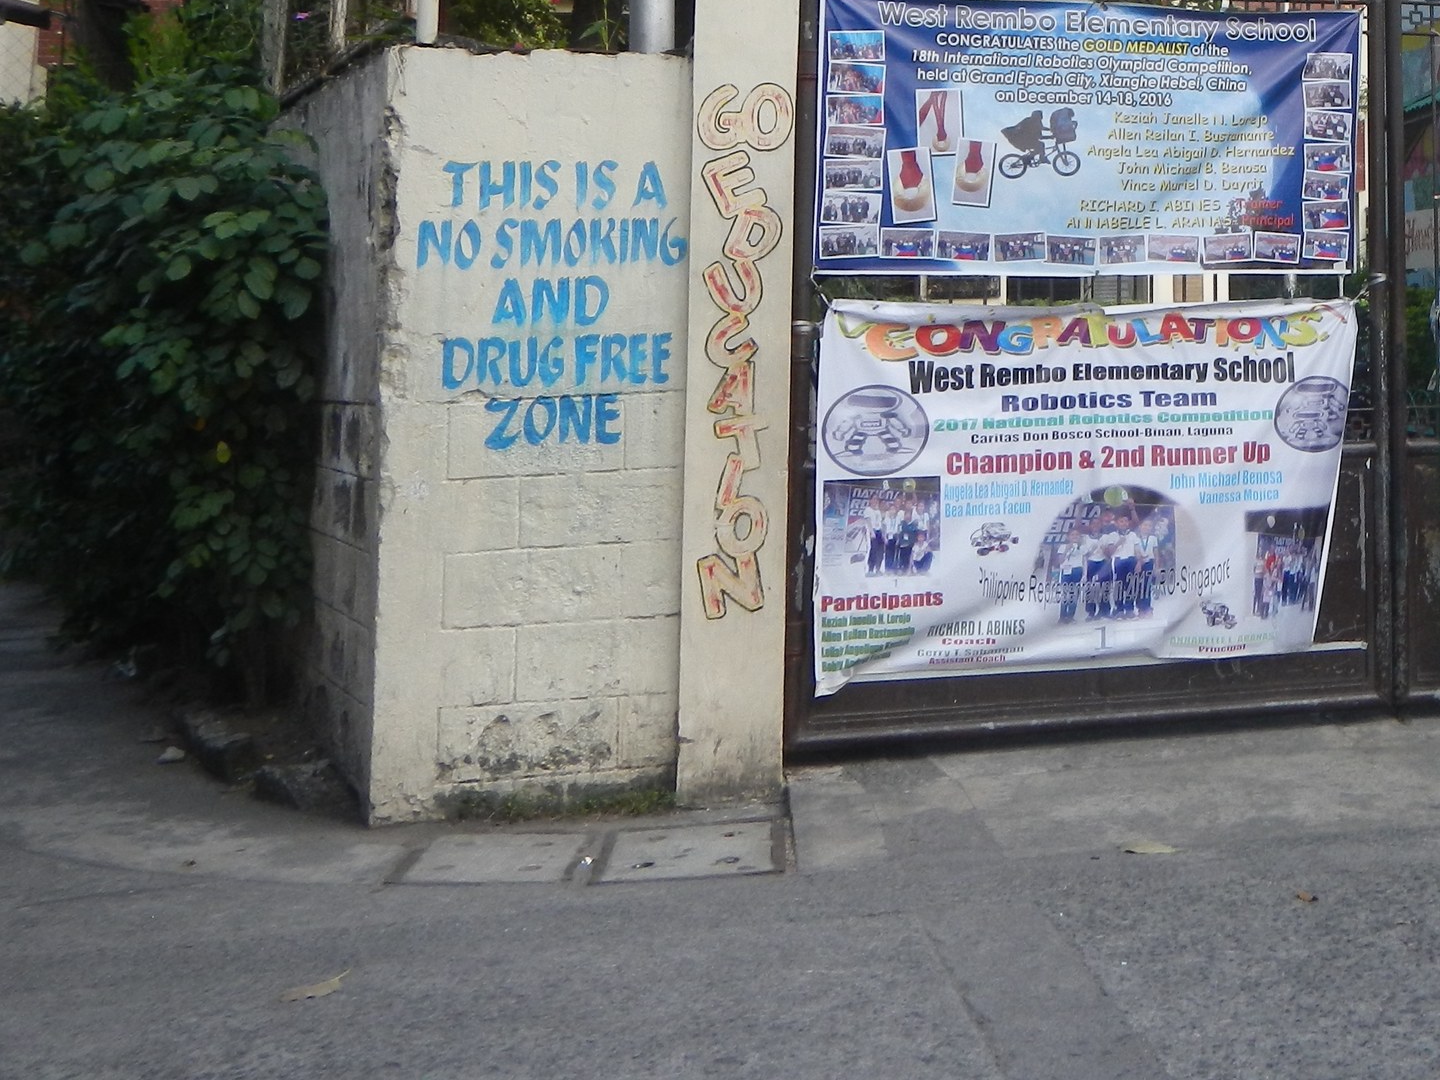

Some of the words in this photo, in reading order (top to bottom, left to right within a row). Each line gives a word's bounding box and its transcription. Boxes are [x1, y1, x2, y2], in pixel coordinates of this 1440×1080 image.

[878, 1, 948, 29] West
[954, 5, 1057, 33] Rembo
[1065, 8, 1220, 43] Elementary
[1225, 17, 1318, 43] School
[936, 32, 1054, 51] CONGRATULATES
[1058, 38, 1080, 51] the
[1084, 38, 1123, 53] GOLD
[1126, 40, 1190, 56] MEDALIST
[1192, 44, 1207, 56] of
[1208, 44, 1230, 57] the
[911, 49, 940, 63] 18th
[943, 51, 1033, 68] International
[1035, 55, 1094, 70] Robotics
[1097, 57, 1164, 73] Olympiad
[1167, 59, 1253, 77] Competition,
[917, 68, 949, 82] held
[951, 69, 968, 82] at
[969, 70, 1016, 85] Grand
[1017, 71, 1064, 87] Epoch
[1065, 72, 1096, 89] City,
[1101, 73, 1157, 91] Xianghe
[1158, 76, 1204, 92] Hebei,
[1206, 78, 1247, 92] China
[995, 91, 1014, 102] on
[1017, 89, 1093, 104] December
[1096, 92, 1138, 107] 14-18,
[1139, 93, 1173, 106] 2016
[697, 82, 794, 152] GO
[443, 159, 562, 211] THIS
[575, 158, 618, 210] IS
[631, 159, 667, 209] A
[416, 219, 481, 270] NO
[490, 216, 688, 269] SMOKING
[492, 274, 610, 327] AND
[864, 311, 1323, 362] CONGRATULATIONS
[442, 335, 565, 389] DRUG
[575, 331, 673, 386] FREE
[695, 150, 784, 620] EDUCATION
[908, 361, 975, 395] West
[980, 363, 1066, 387] Rembo
[1072, 360, 1208, 384] Elementary
[1213, 352, 1296, 383] School
[1001, 391, 1132, 412] Robotics
[1139, 391, 1218, 408] Team
[484, 391, 625, 450] ZONE
[933, 418, 977, 432] 2017
[982, 414, 1064, 429] National
[1068, 411, 1153, 427] Robotics
[1156, 408, 1274, 423] Competition
[970, 432, 1019, 445] Caritas
[1022, 431, 1049, 441] Don
[1051, 429, 1092, 440] Bosco
[1187, 426, 1233, 439] Laguna
[946, 449, 1072, 476] Champion
[1078, 450, 1095, 469] &
[1100, 445, 1145, 468] 2nd
[1151, 442, 1237, 466] Runner
[1243, 440, 1271, 465] Up
[944, 482, 973, 502] Angela
[974, 483, 989, 498] Lea
[990, 482, 1020, 500] Abigail
[1030, 478, 1074, 496] Hernandez
[1169, 472, 1196, 490] John
[1198, 470, 1241, 488] Michael
[1242, 468, 1283, 486] Benosa
[1199, 490, 1243, 504] Vanessa
[1244, 488, 1280, 503] Mojica
[944, 504, 964, 518] Bea
[965, 502, 1000, 517] Andrea
[1002, 501, 1031, 515] Facun
[820, 590, 944, 613] Participants
[942, 637, 997, 646] Coach
